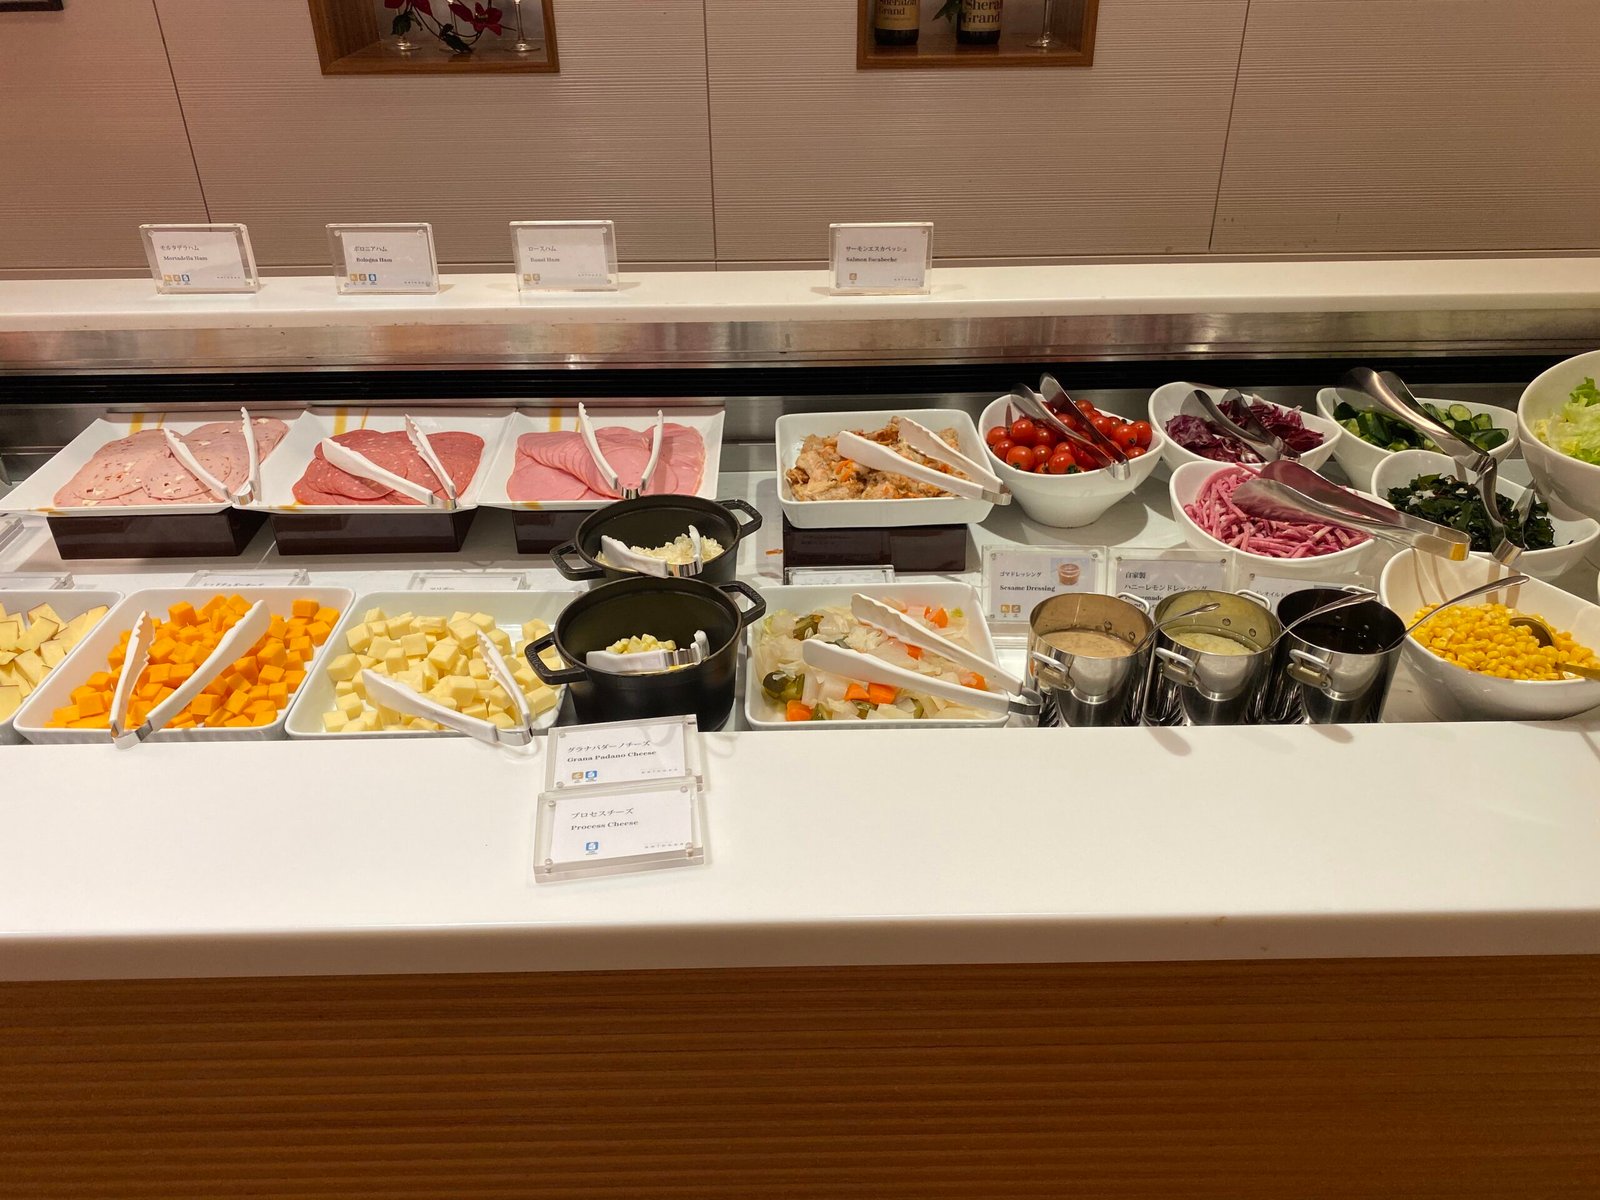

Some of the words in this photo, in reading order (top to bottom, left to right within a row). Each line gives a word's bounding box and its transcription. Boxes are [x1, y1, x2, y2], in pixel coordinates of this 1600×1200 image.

[964, 12, 1000, 23] Grand
[1125, 571, 1146, 579] 自家製
[627, 750, 657, 758] Cheese
[571, 807, 634, 819] プロセスチーズ
[570, 823, 606, 831] Process
[607, 820, 639, 828] Cheese
